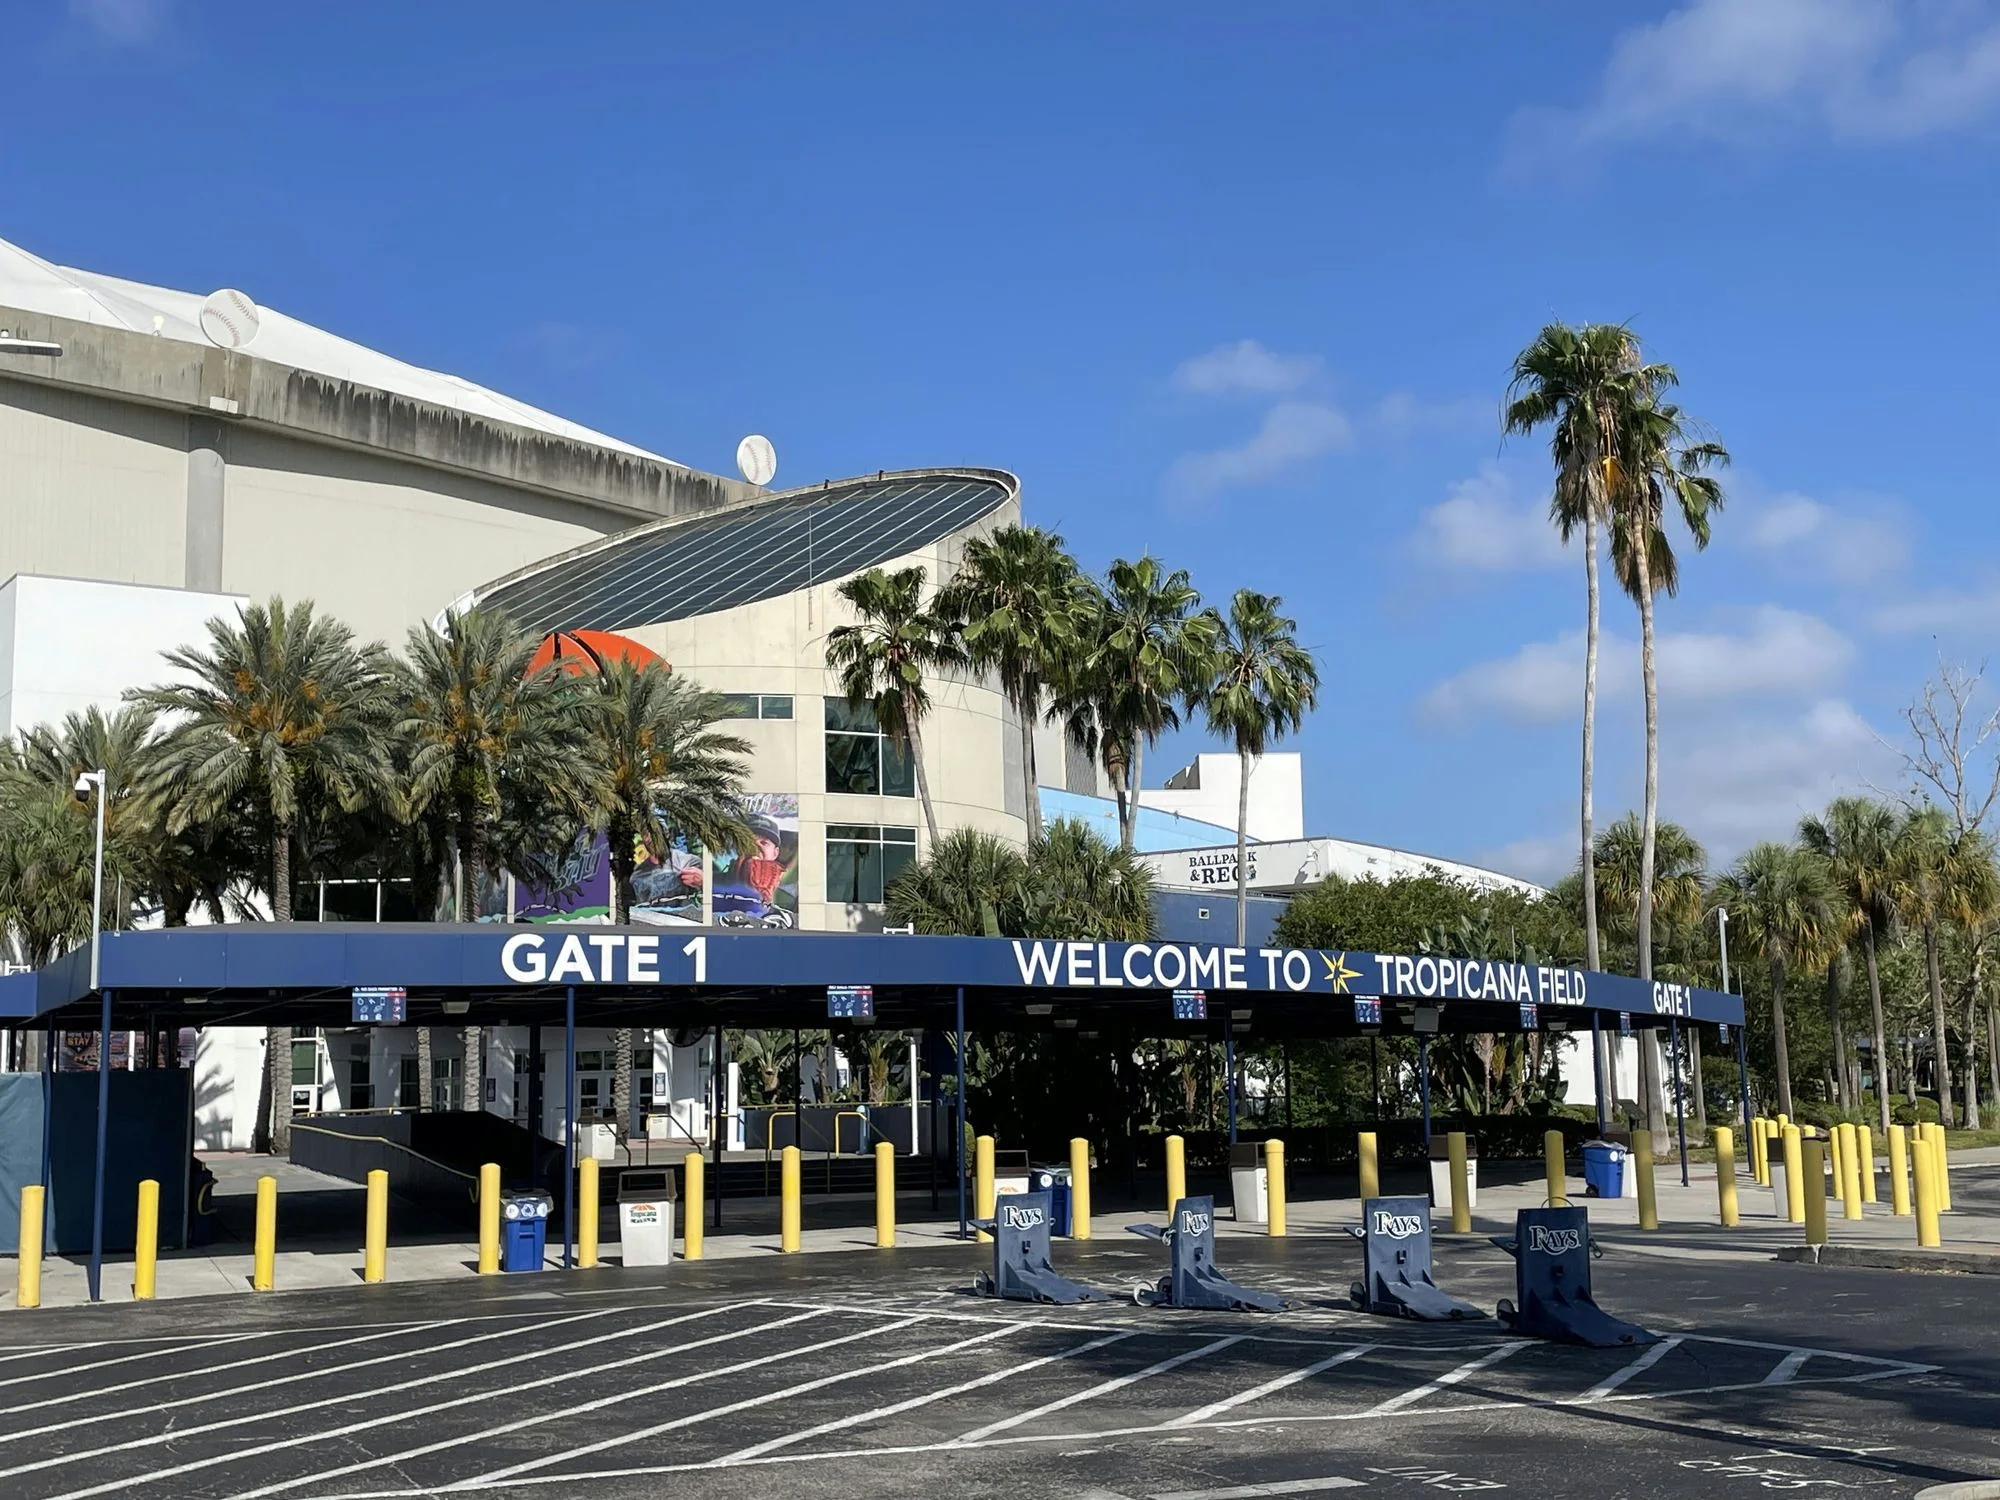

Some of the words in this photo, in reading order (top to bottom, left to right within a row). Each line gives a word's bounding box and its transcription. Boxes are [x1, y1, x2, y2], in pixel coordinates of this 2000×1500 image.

[1189, 852, 1257, 867] BALLPAK
[501, 933, 660, 983] GATE
[682, 936, 707, 983] 1
[1012, 941, 1248, 989] WELCOME
[1259, 949, 1311, 991] TO
[1375, 954, 1534, 1001] TROPICANA
[1538, 966, 1586, 1005] FIELD
[1653, 982, 1683, 1016] GATE
[1684, 985, 1692, 1016] 1
[67, 1037, 90, 1046] STAY
[1363, 1466, 1508, 1491] EXIT
